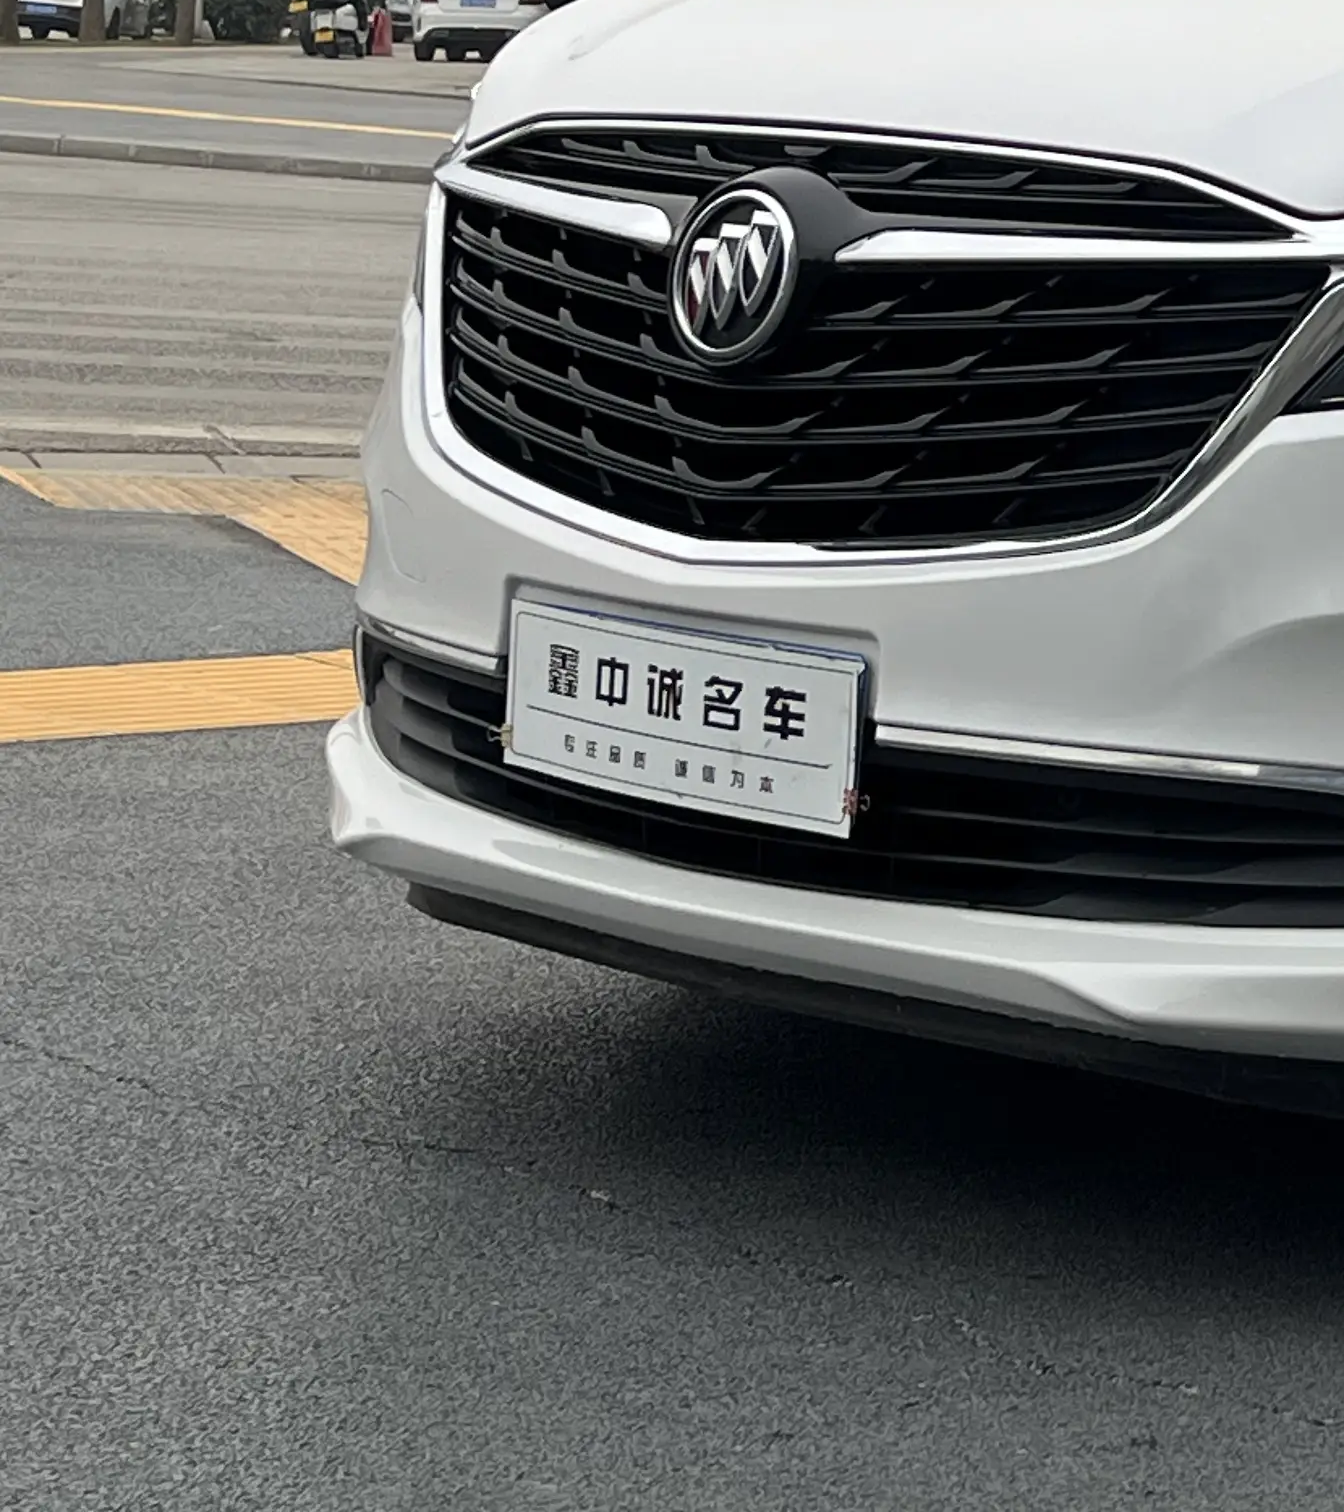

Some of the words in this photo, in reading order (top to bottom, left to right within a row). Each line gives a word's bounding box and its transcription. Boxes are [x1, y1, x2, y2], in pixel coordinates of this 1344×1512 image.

[547, 643, 807, 741] 鑫中诚名车
